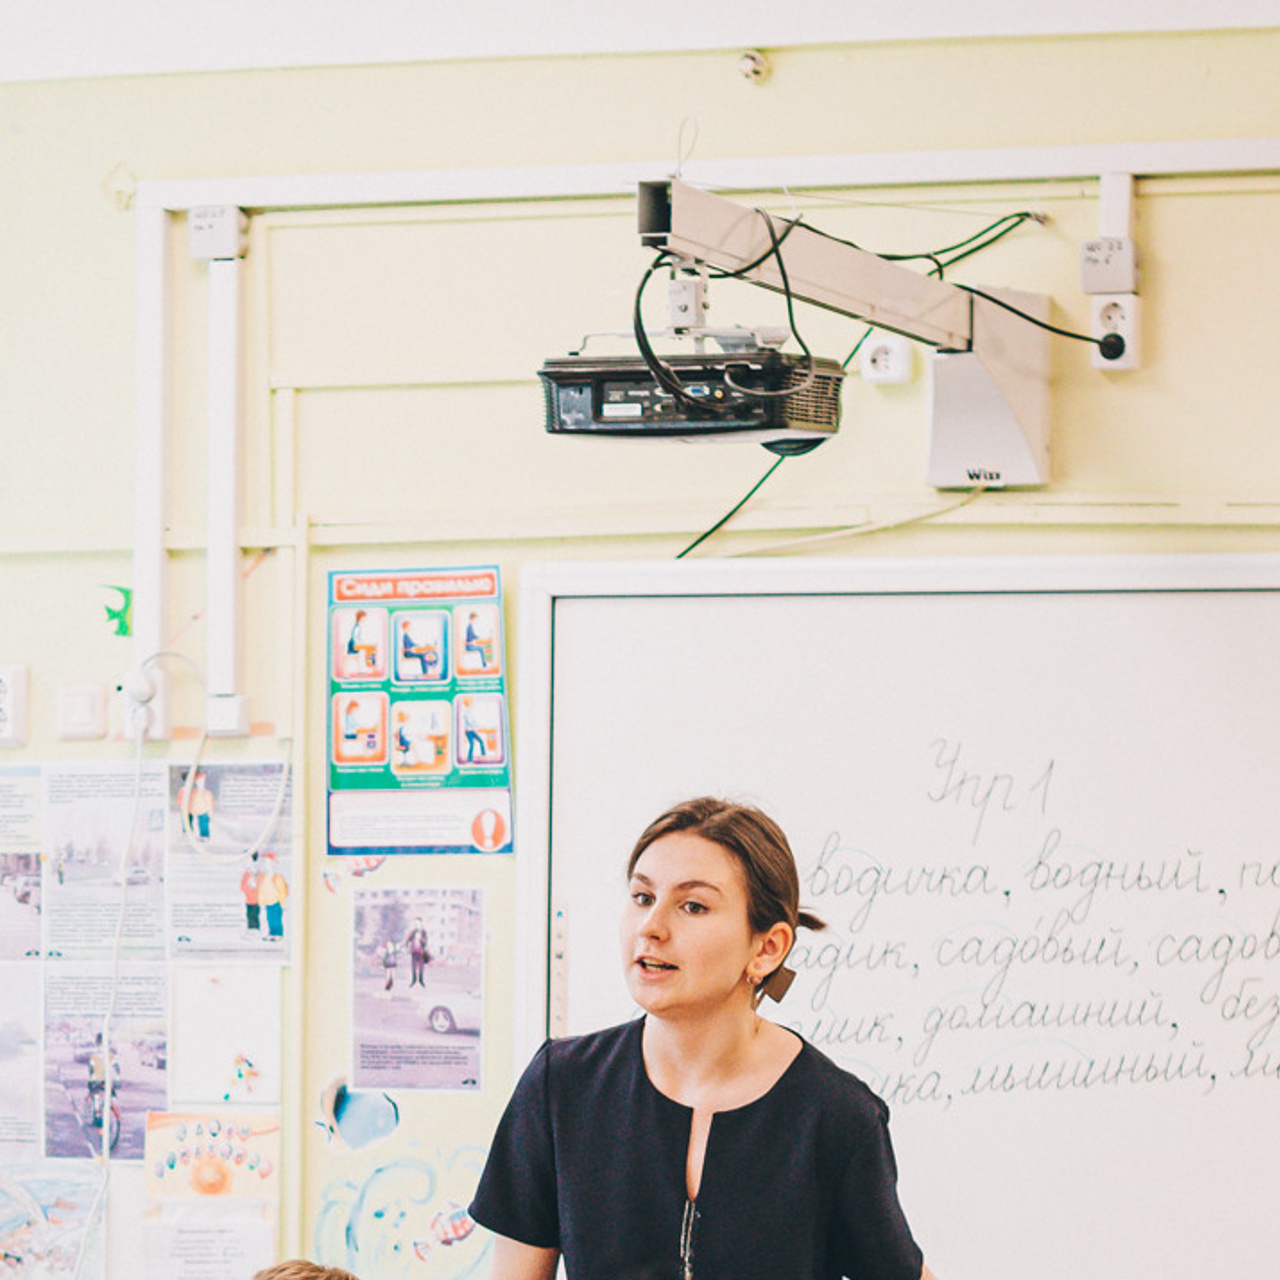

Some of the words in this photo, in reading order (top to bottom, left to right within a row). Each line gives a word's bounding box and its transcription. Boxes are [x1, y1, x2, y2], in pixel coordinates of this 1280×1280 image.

[340, 578, 393, 596] Сиди
[396, 576, 493, 596] правильно
[927, 737, 1017, 845] Упр
[1028, 758, 1055, 815] 1
[789, 940, 919, 1012] адик,
